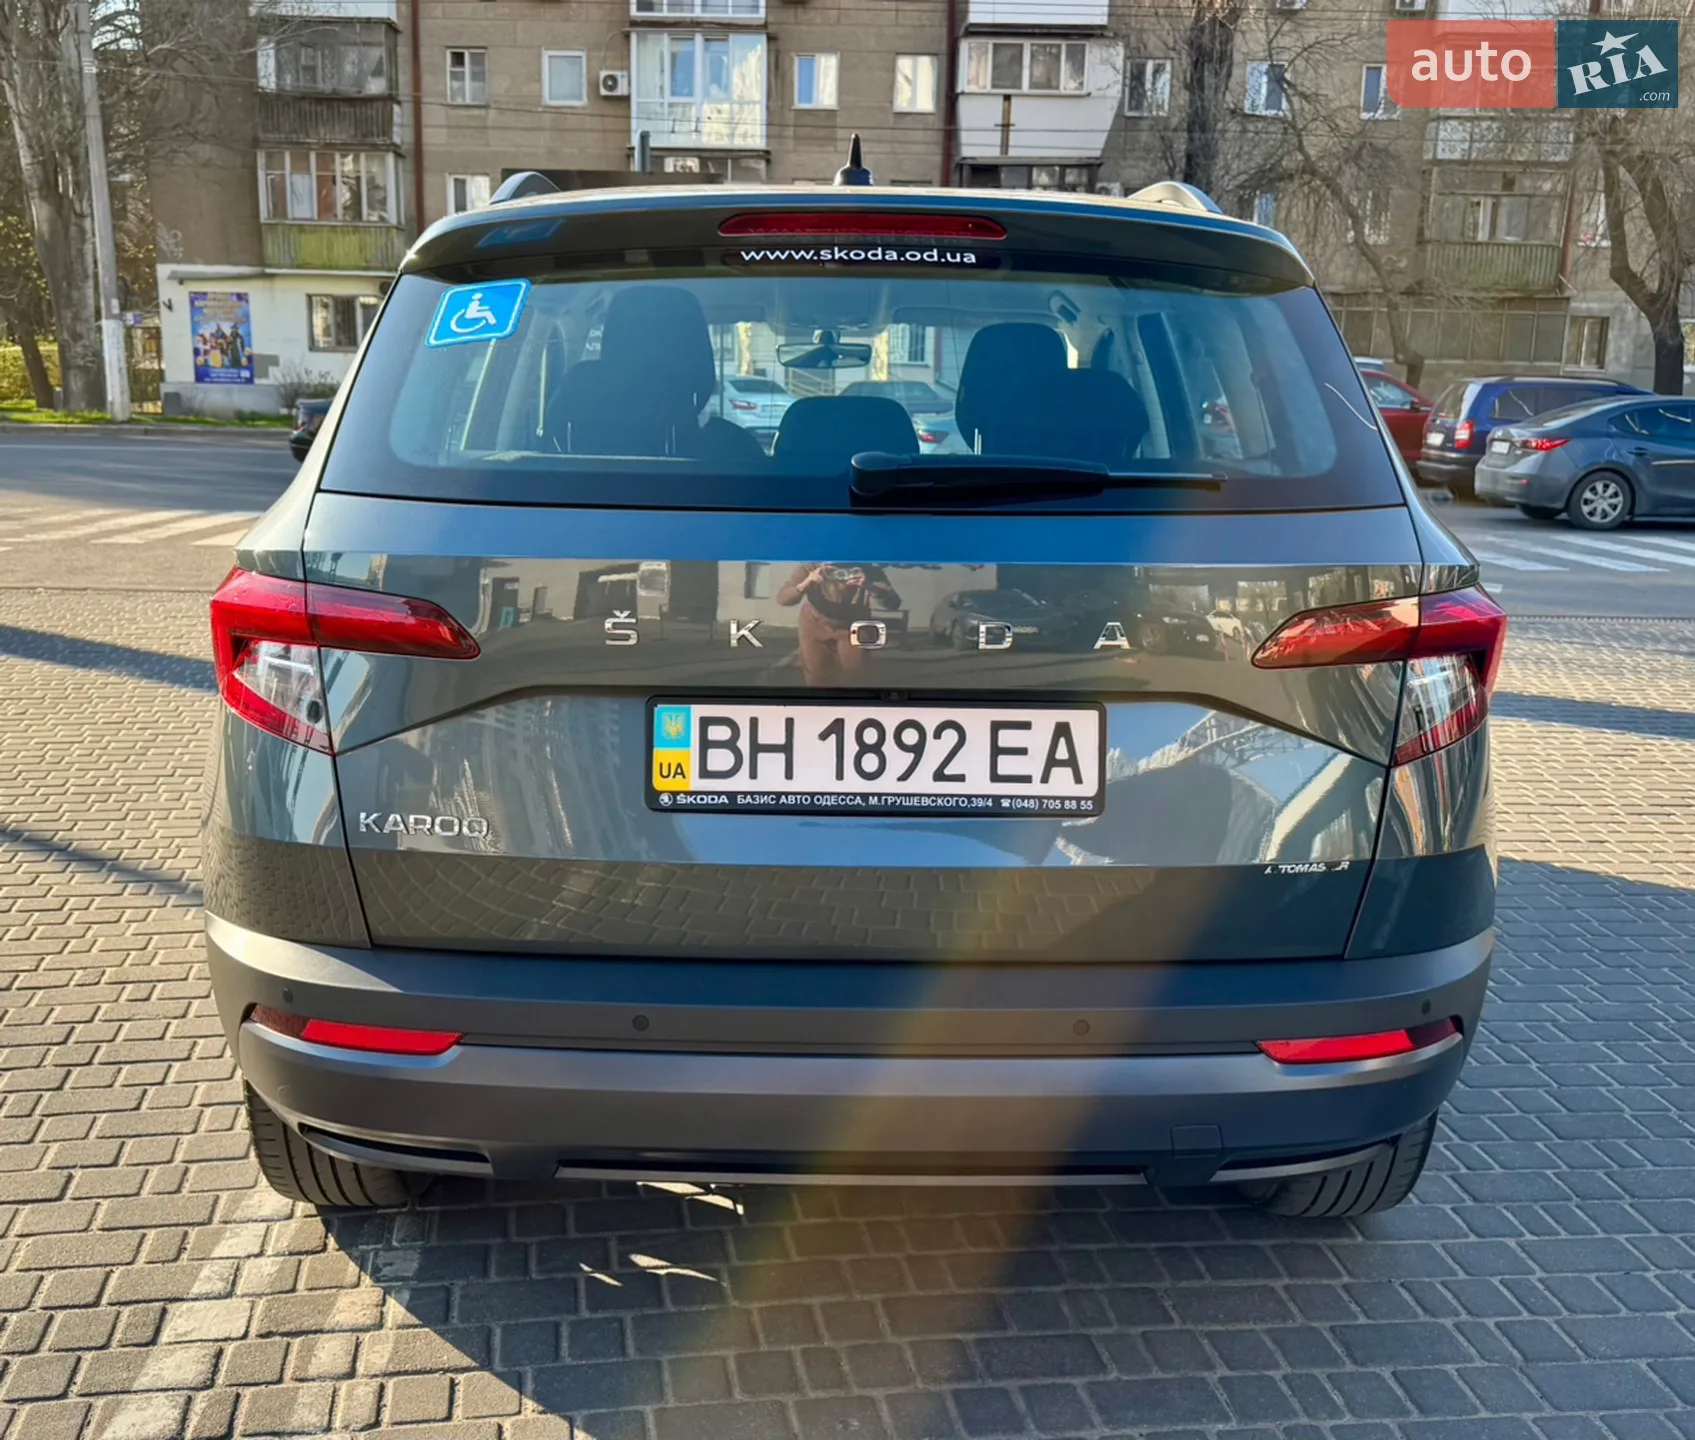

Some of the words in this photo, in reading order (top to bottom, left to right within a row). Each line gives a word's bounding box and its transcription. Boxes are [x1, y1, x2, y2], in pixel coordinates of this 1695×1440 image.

[740, 246, 976, 264] www.skoda.od.ua
[818, 717, 966, 783] 1892
[989, 719, 1083, 785] EA
[658, 762, 686, 780] UA
[737, 794, 776, 805] БАЗИС
[779, 795, 811, 806] АВТО
[1042, 799, 1062, 810] 705
[1064, 799, 1077, 810] 88
[1080, 800, 1093, 811] 55
[359, 812, 489, 840] KAROQ
